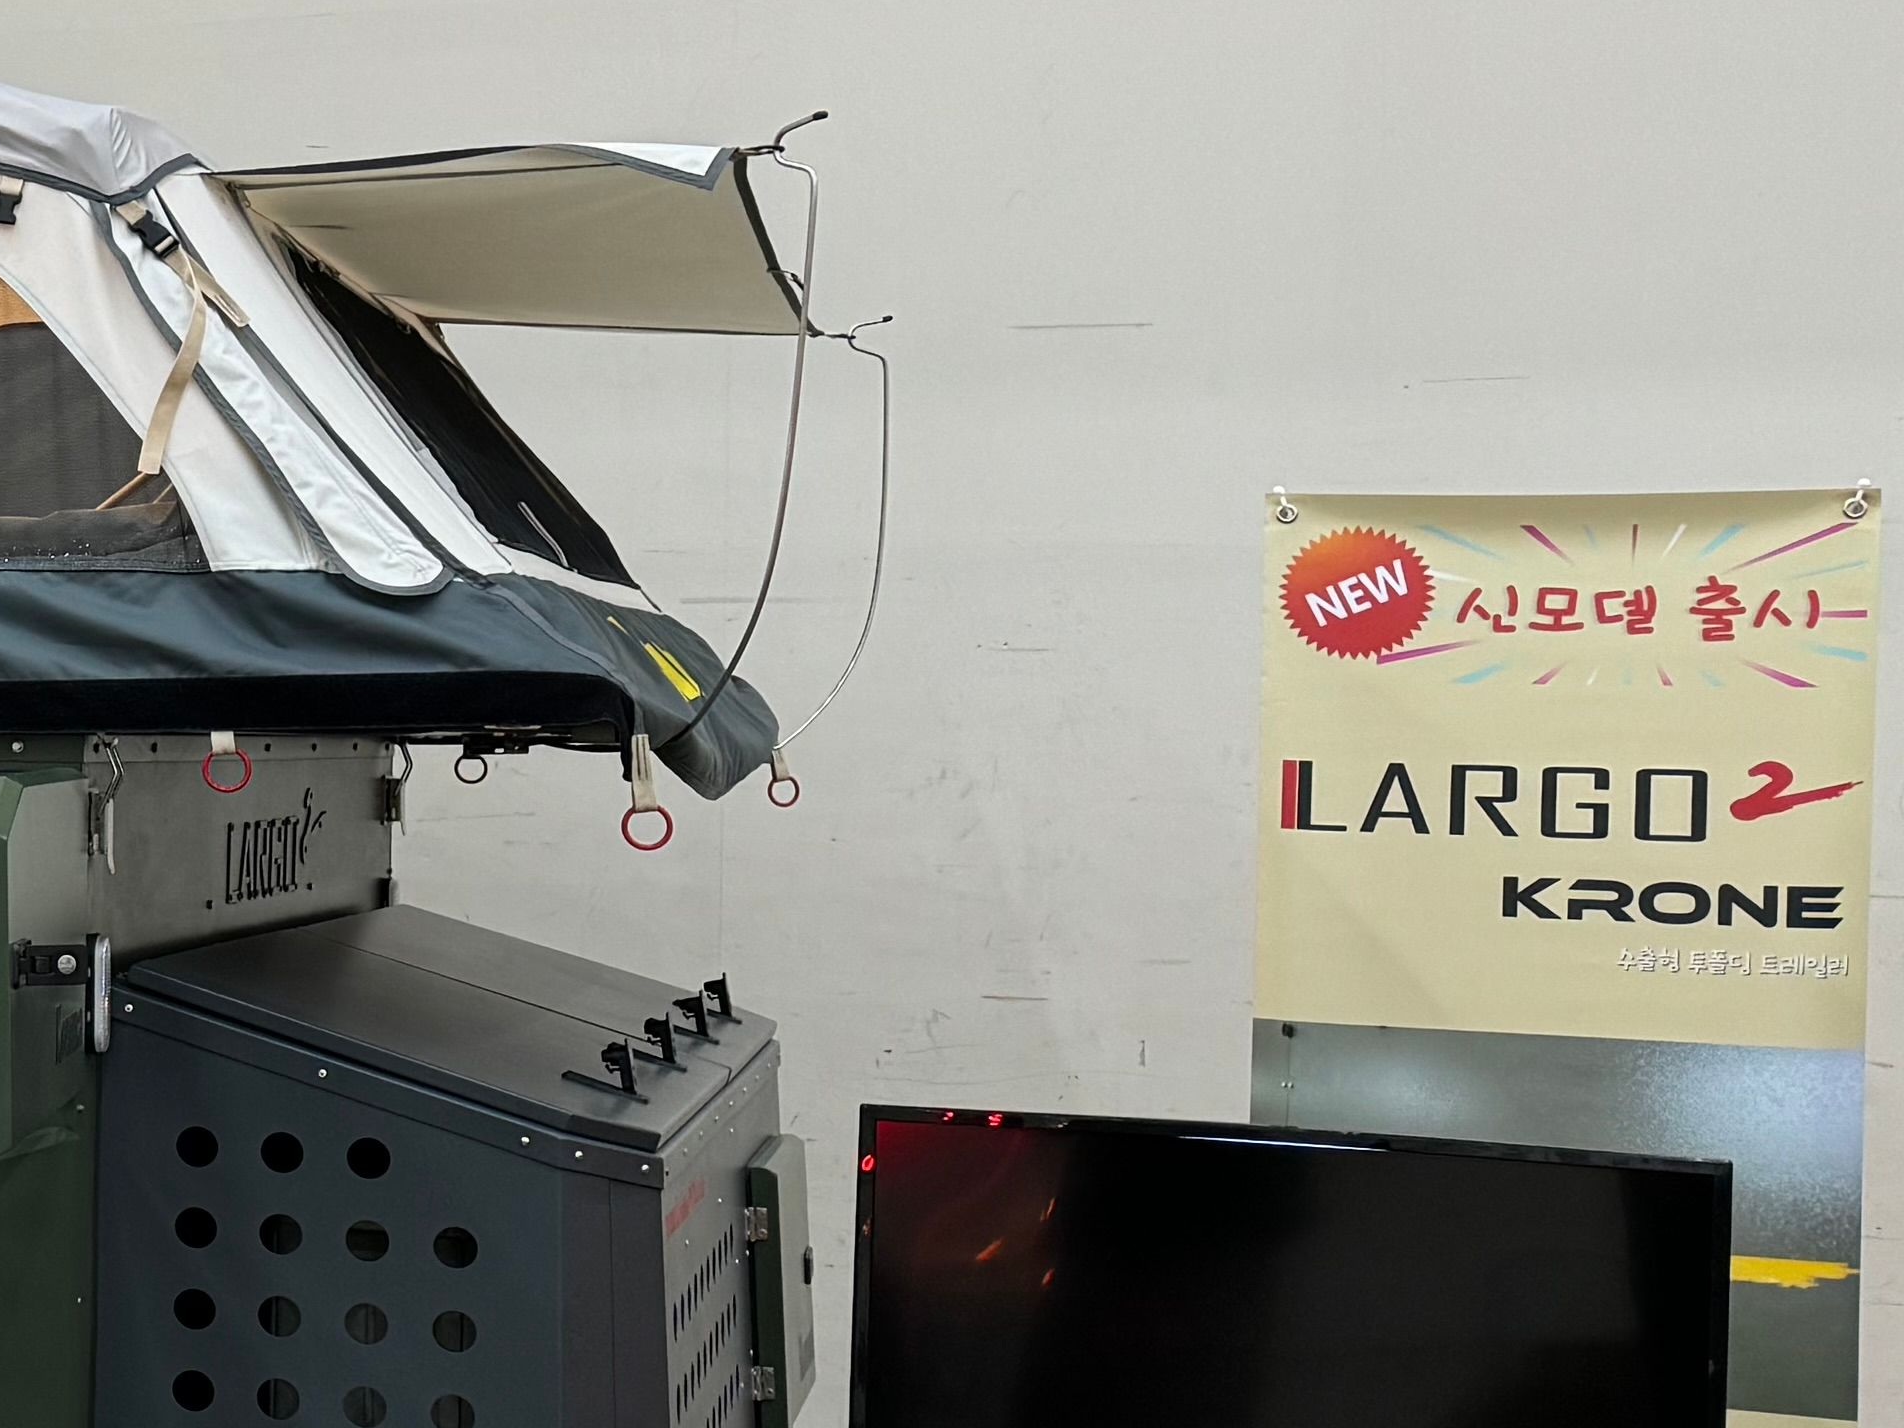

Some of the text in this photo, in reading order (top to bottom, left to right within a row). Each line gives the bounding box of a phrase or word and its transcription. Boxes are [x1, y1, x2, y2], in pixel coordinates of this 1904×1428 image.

[1303, 558, 1409, 627] NEW
[1455, 583, 1658, 636] 신모델
[1280, 759, 1864, 842] LARGO 2
[225, 815, 299, 904] LARGO
[1501, 876, 1844, 929] KRONE
[1616, 946, 1849, 979] 수출형 투폴딩 트레일러
